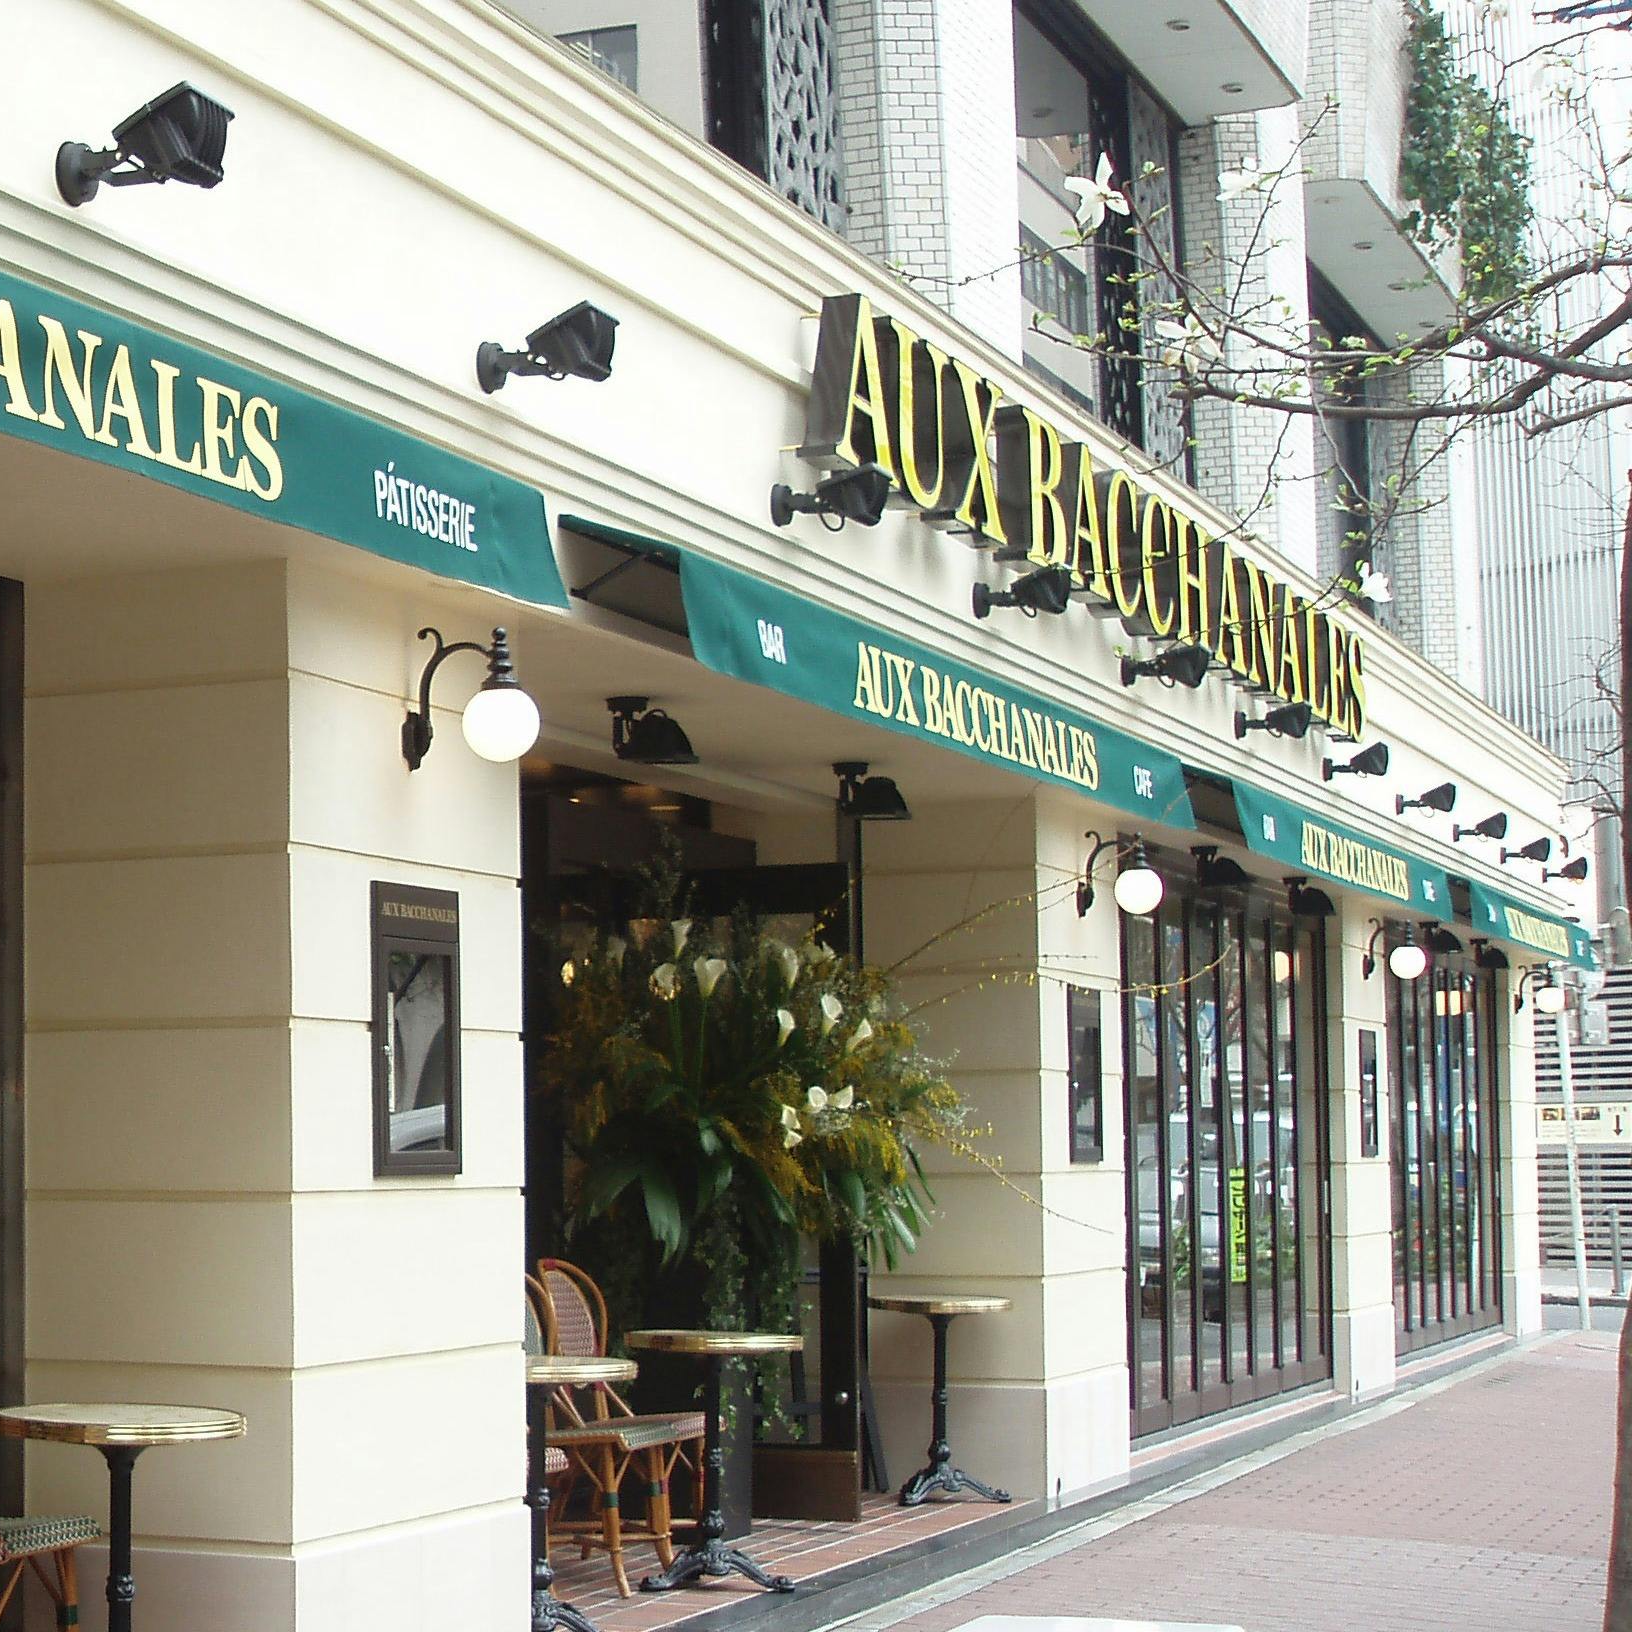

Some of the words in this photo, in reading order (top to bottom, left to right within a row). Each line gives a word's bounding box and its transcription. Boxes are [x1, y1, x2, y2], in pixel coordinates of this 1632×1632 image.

[835, 292, 1008, 546] AUX
[1026, 404, 1366, 743] BACCHANALES
[757, 619, 787, 665] BAR
[853, 641, 920, 727] AUX
[919, 665, 1099, 791] BACCHANALES
[1301, 820, 1330, 873] AUX
